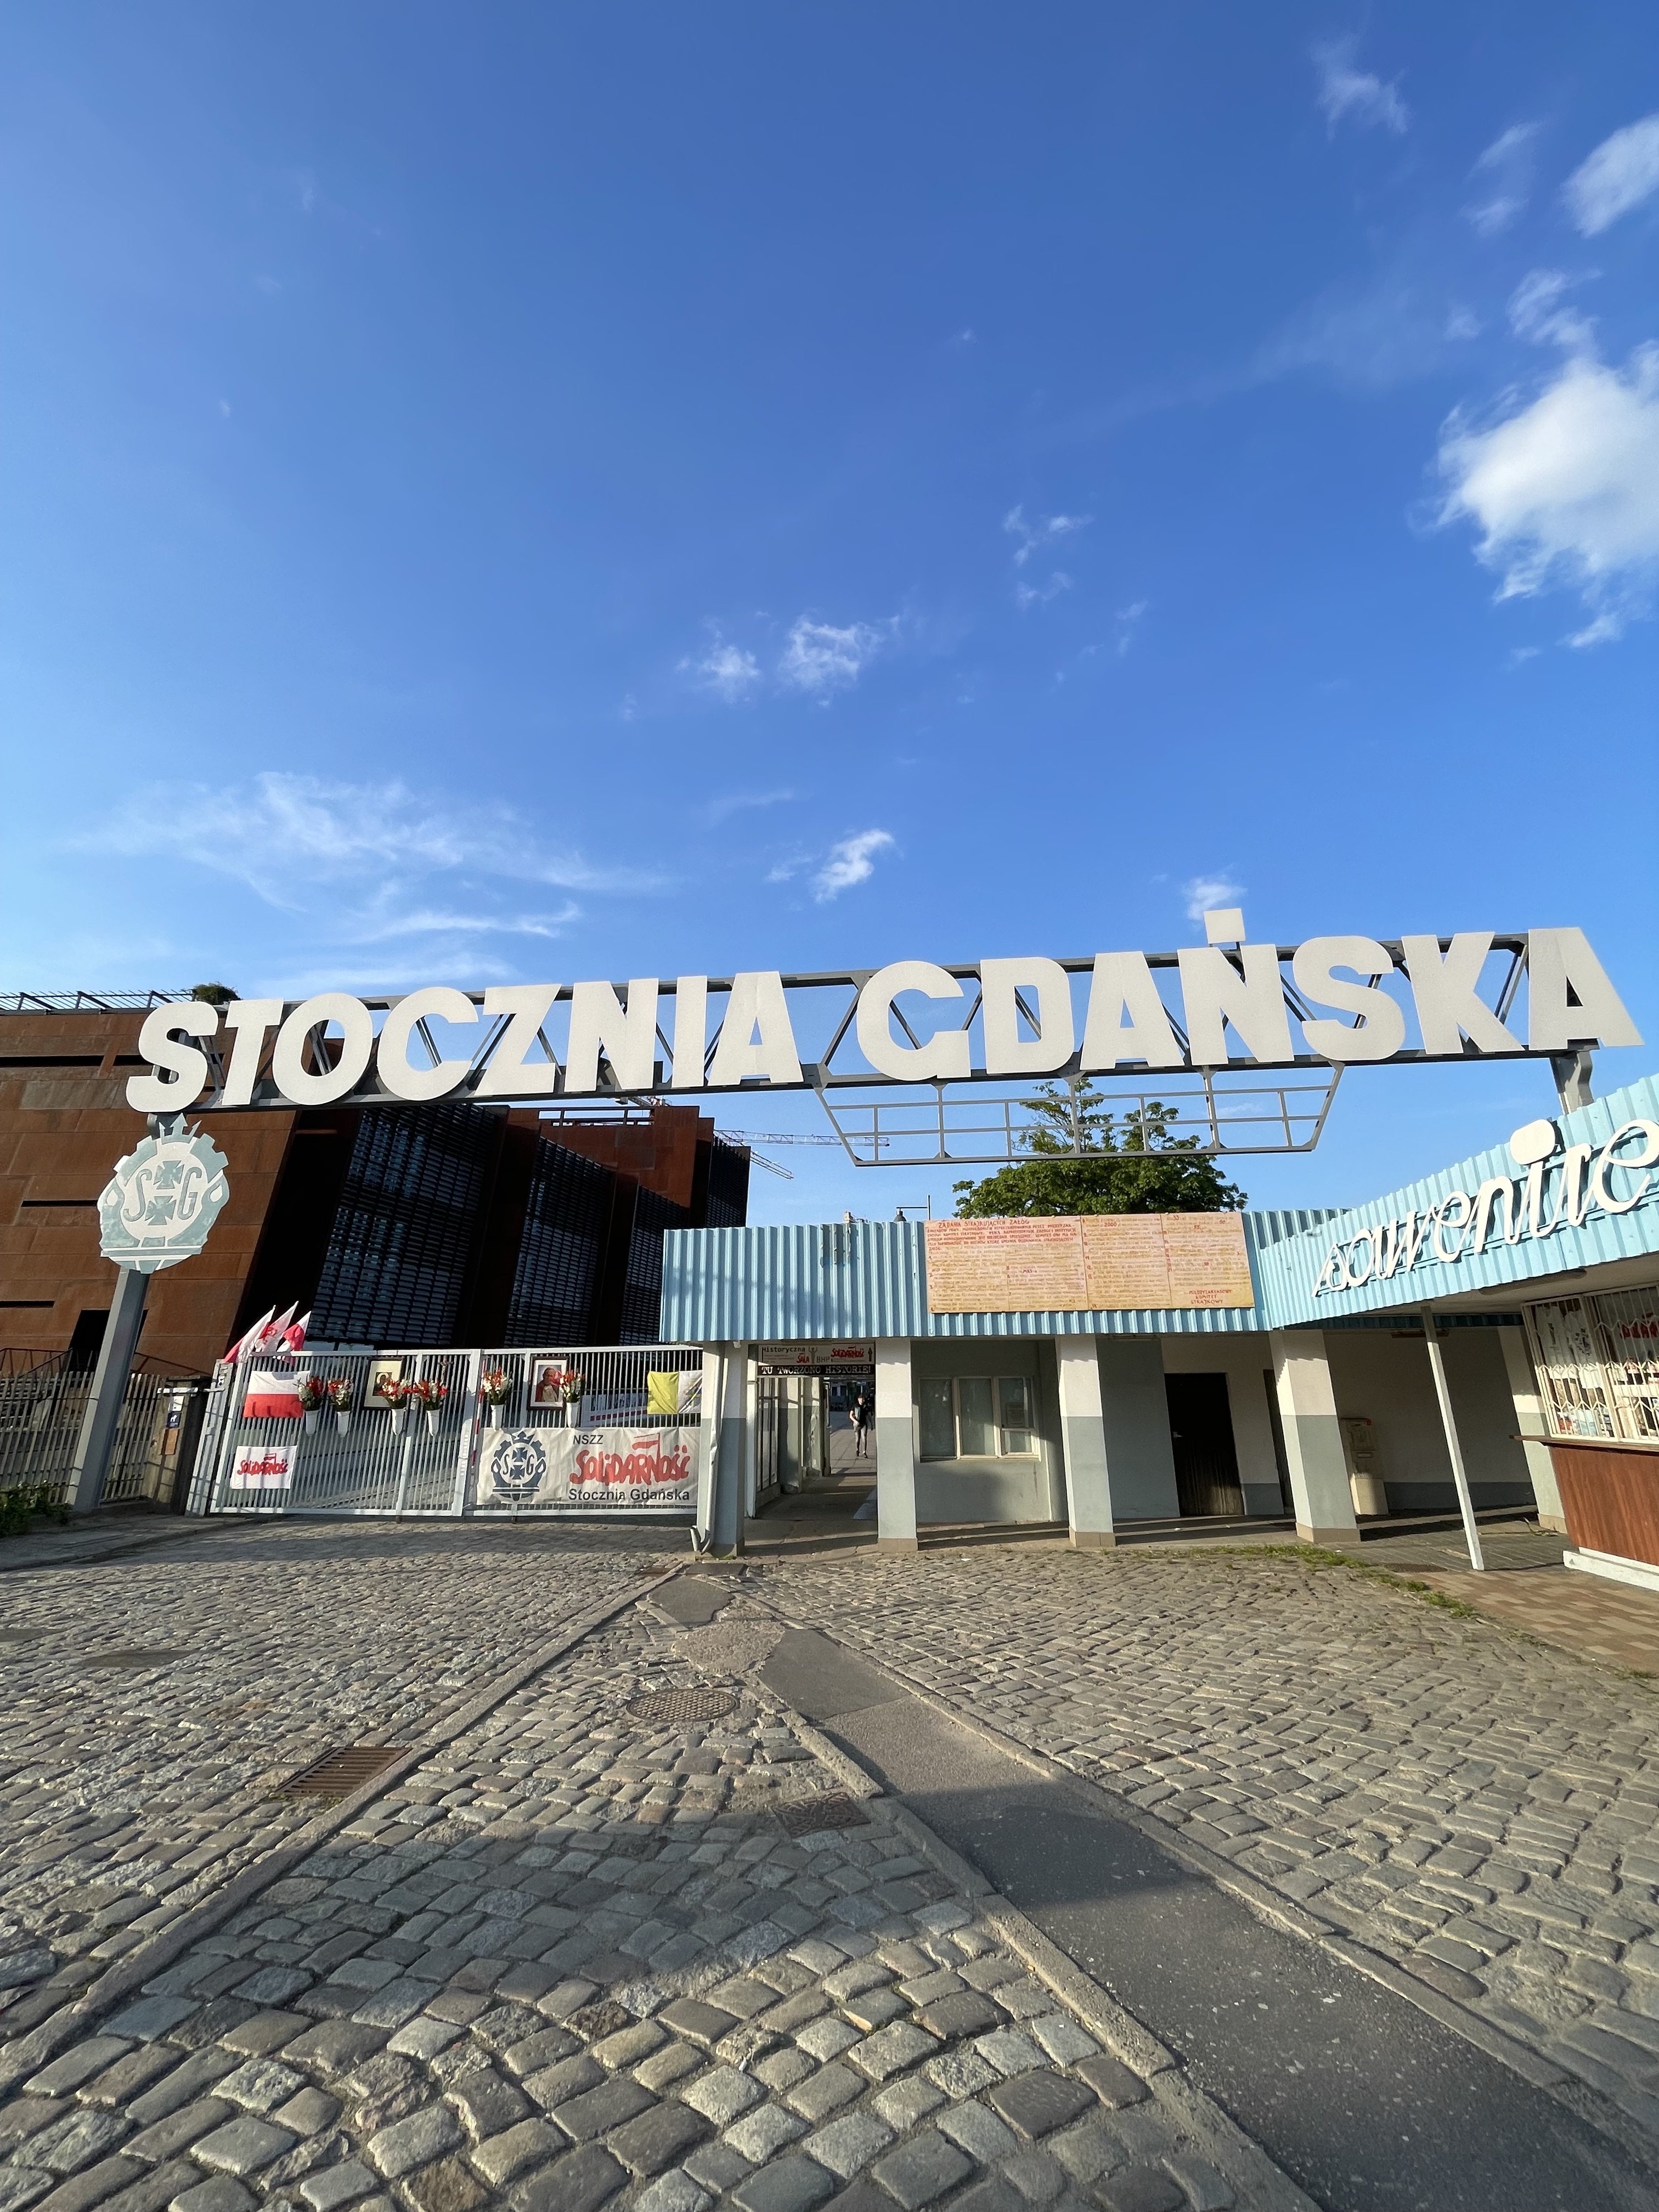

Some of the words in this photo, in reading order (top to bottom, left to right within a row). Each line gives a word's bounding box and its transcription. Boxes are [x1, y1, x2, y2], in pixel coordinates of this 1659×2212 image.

[125, 970, 804, 1113] STOCZNIA
[857, 907, 1644, 1081] GDAŃSKA
[777, 1366, 821, 1374] TWORZONO
[573, 1435, 603, 1444] NSZZ
[568, 1488, 625, 1500] Stocznia
[630, 1487, 690, 1500] Gdańska
